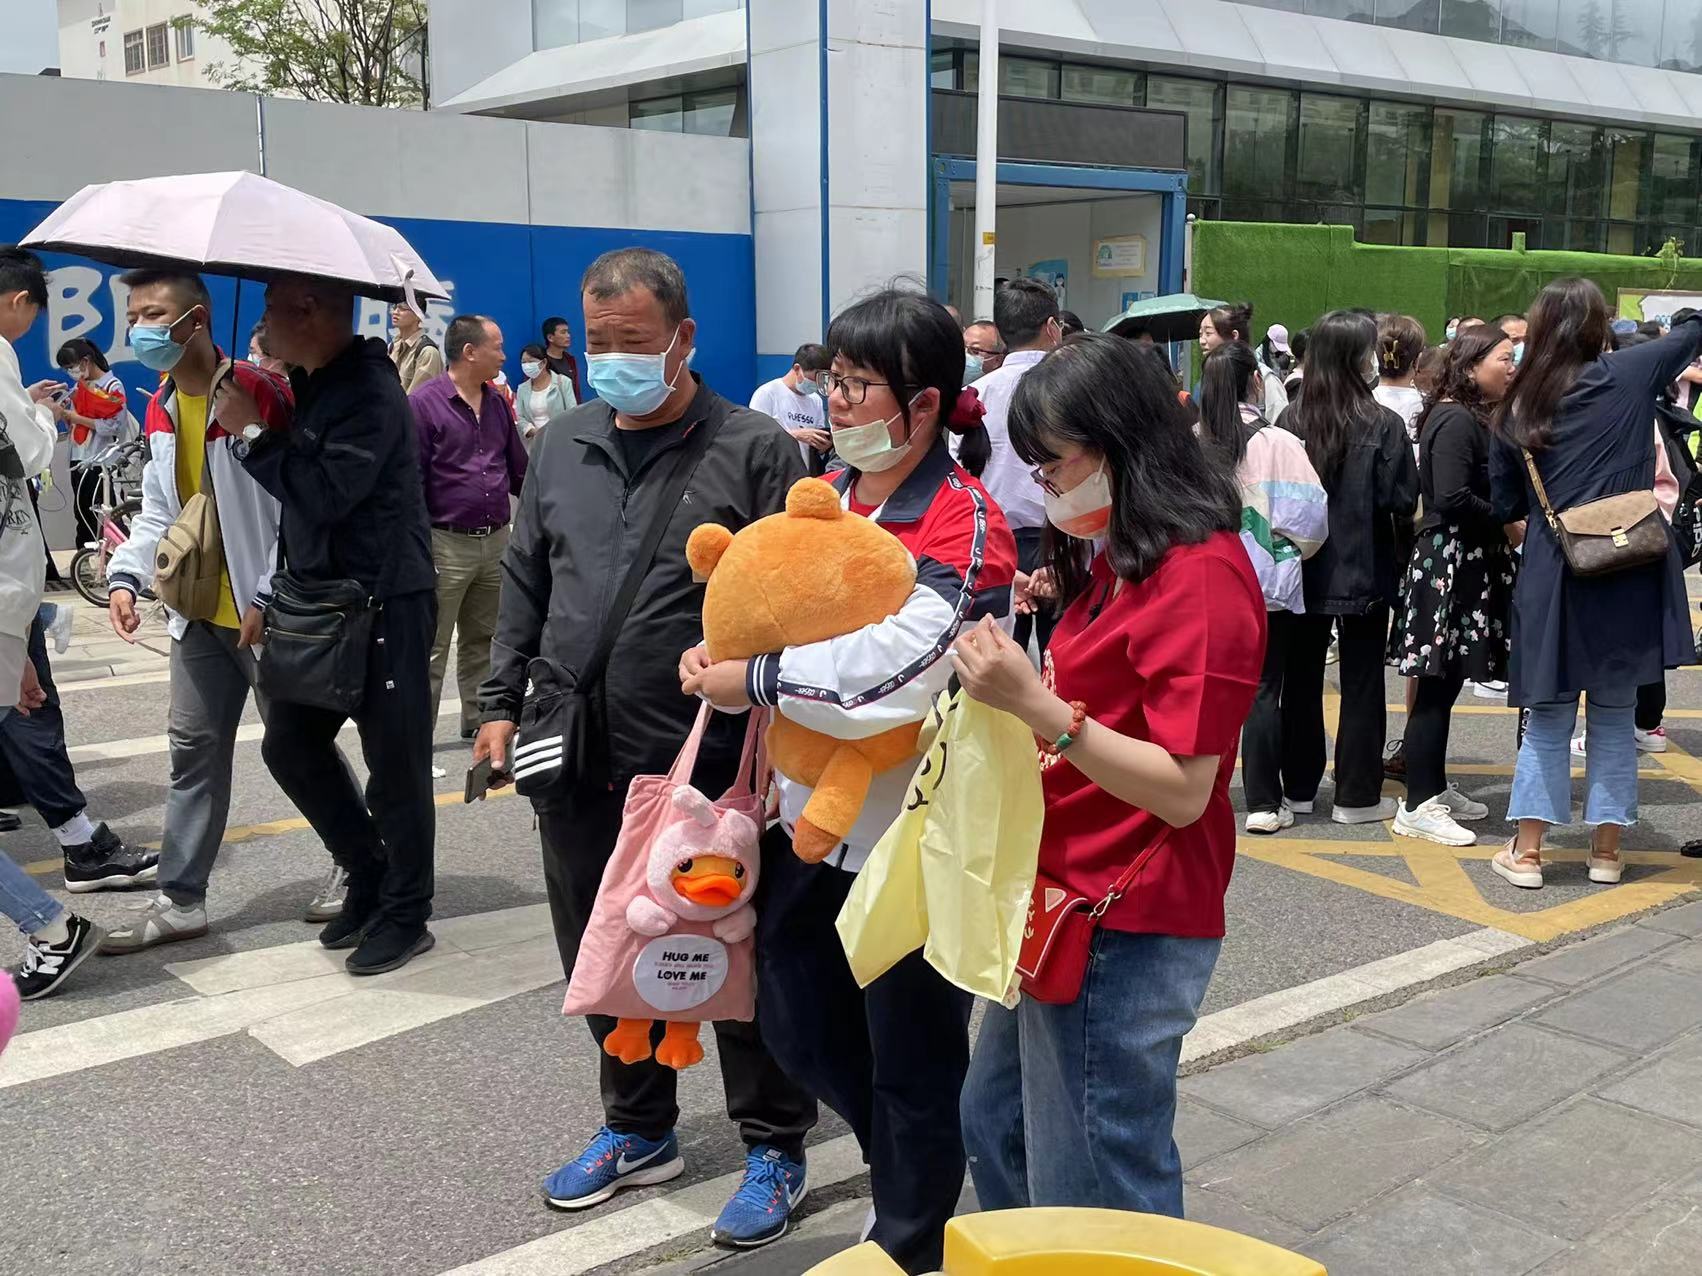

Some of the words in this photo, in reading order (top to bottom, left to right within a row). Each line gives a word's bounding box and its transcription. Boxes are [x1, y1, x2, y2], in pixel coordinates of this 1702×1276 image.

[662, 951, 690, 961] HUG
[691, 953, 710, 962] ME
[657, 970, 687, 980] LOVE
[689, 971, 707, 980] ME
